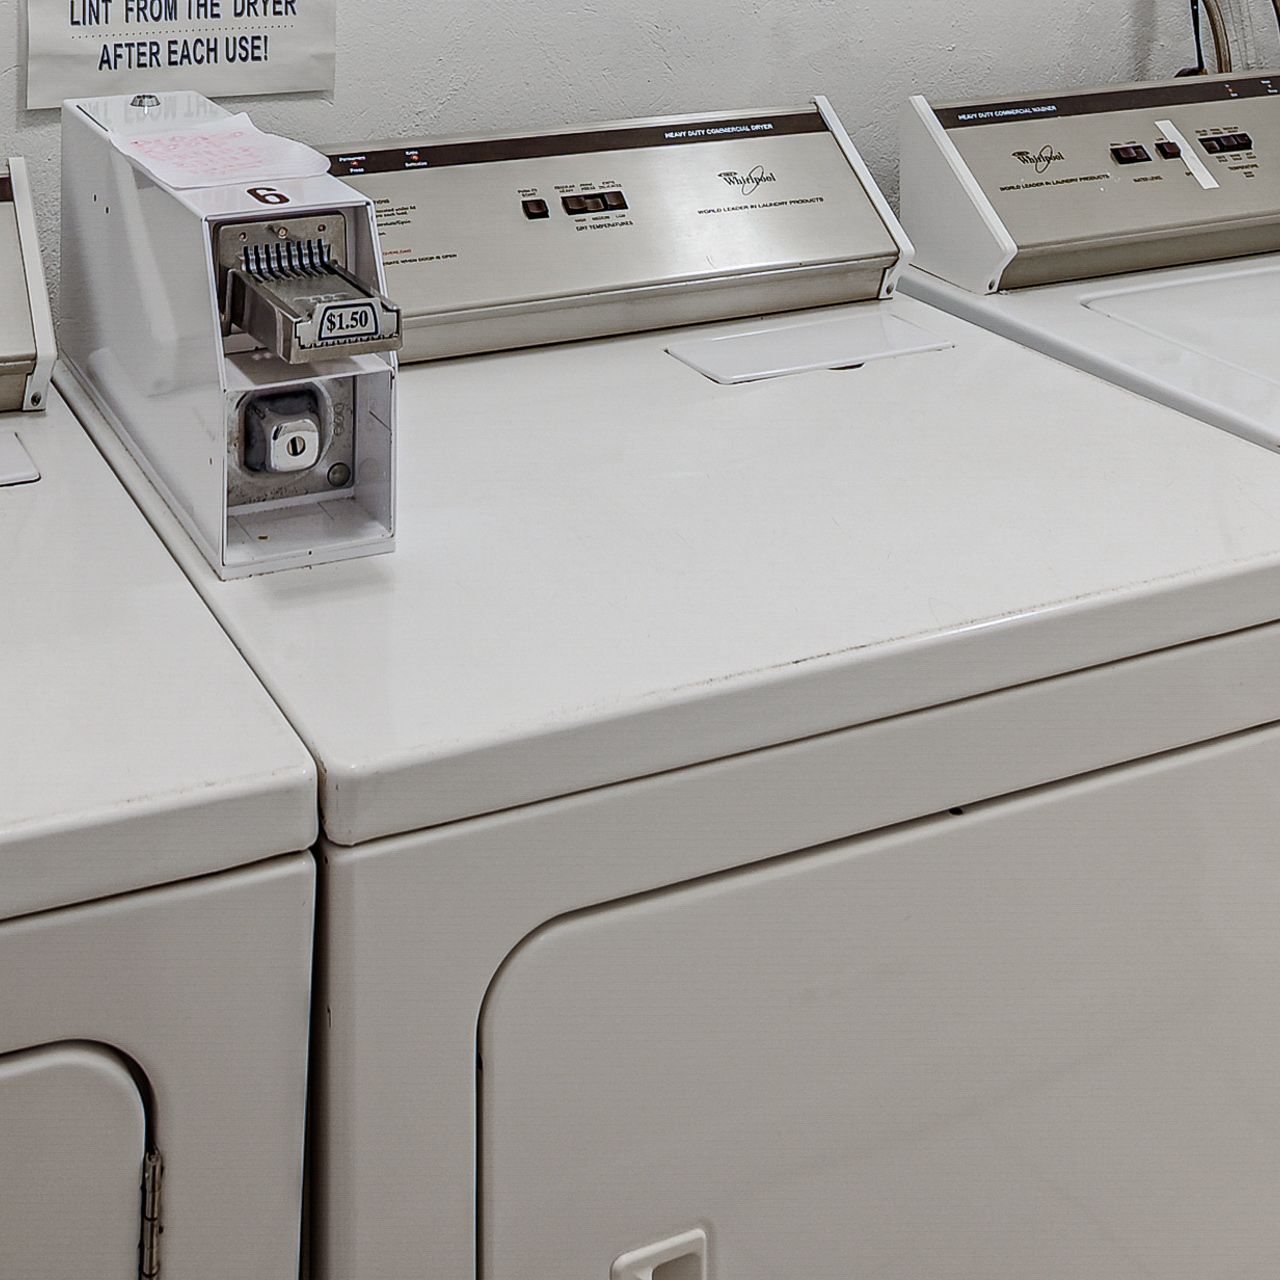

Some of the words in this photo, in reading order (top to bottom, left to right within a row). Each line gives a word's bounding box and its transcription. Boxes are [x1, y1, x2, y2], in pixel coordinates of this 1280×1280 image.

[98, 41, 161, 71] AFTER
[168, 38, 217, 65] EACH
[225, 36, 268, 63] USE!
[665, 131, 686, 139] HEAVY
[706, 126, 750, 135] COMMERCIAL
[1018, 152, 1064, 165] Whirlpool
[724, 172, 776, 185] Whirlpool
[247, 187, 290, 205] 6
[789, 197, 824, 205] PRODUCTS
[326, 311, 369, 333] $1.50
